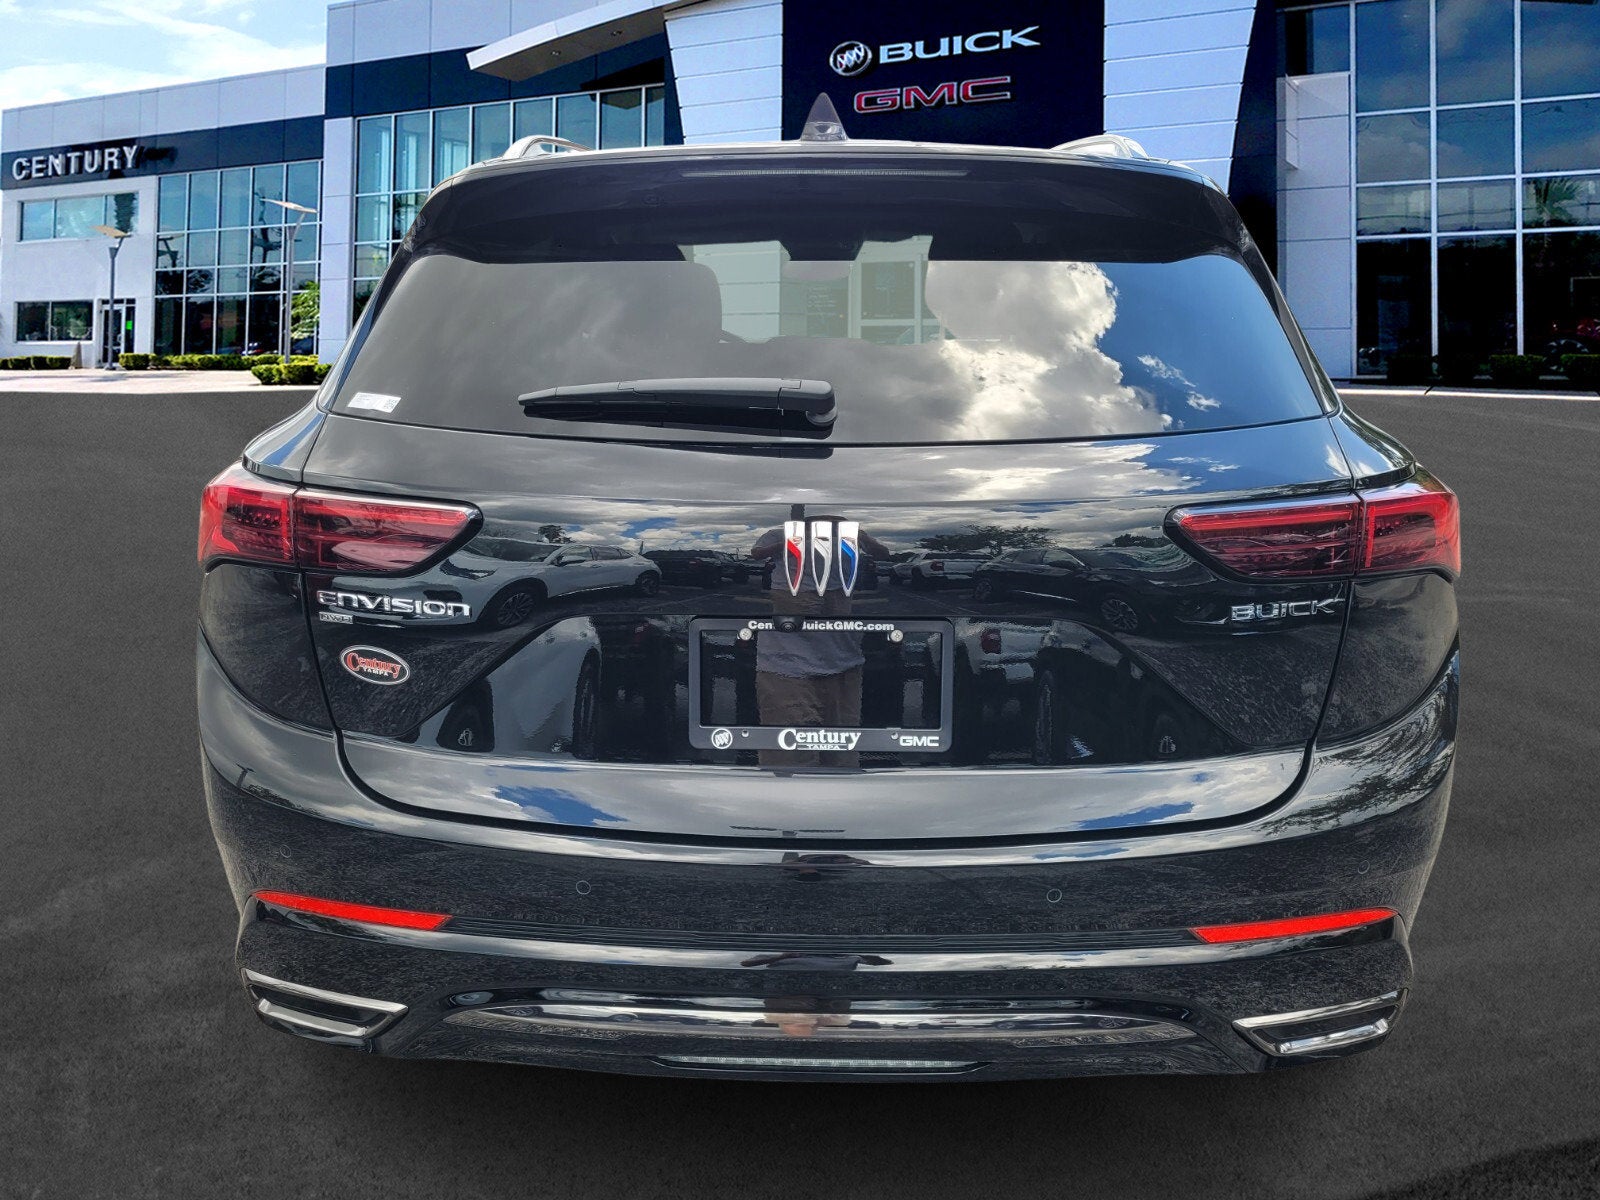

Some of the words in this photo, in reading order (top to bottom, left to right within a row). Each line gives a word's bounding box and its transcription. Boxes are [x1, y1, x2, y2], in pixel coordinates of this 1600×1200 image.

[879, 25, 1041, 64] BUICK
[854, 75, 1011, 114] GMC
[12, 144, 138, 181] CENTURY
[1231, 598, 1339, 621] BUICK
[748, 620, 895, 631] CenuickGMC.com
[347, 652, 401, 679] Century
[362, 666, 389, 677] TAMPA
[778, 728, 861, 750] Century
[899, 735, 940, 746] GMC
